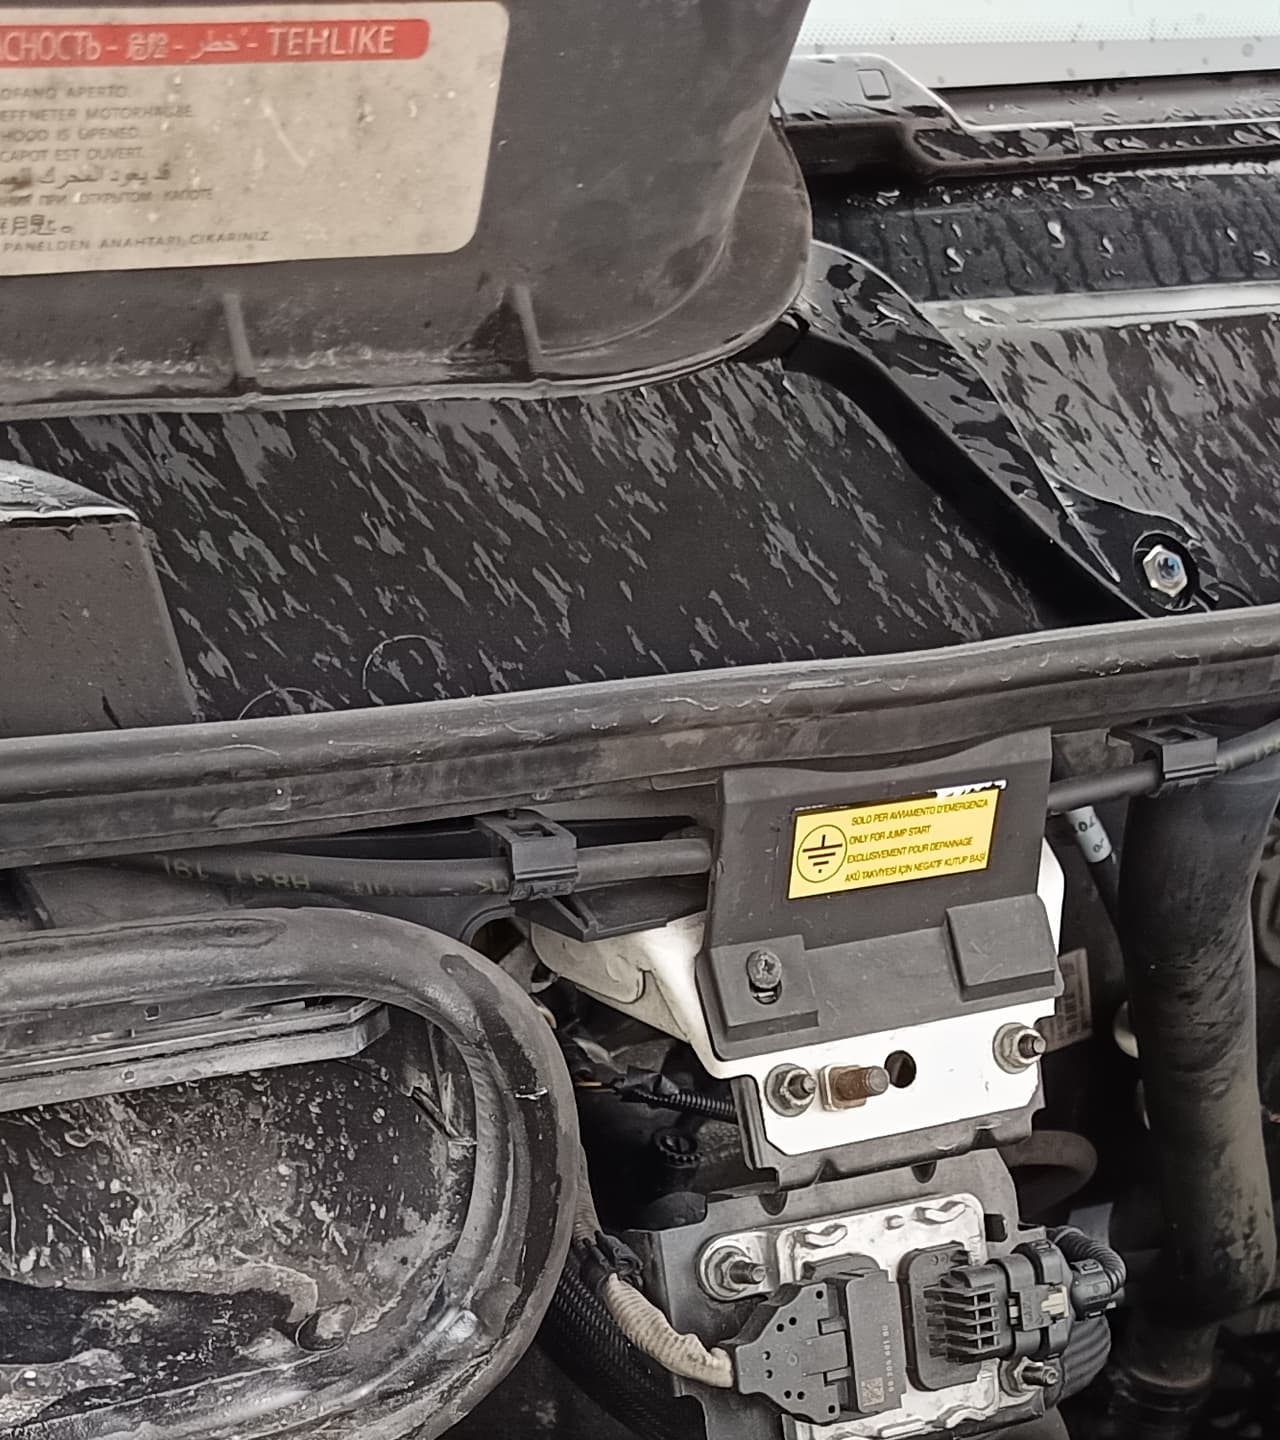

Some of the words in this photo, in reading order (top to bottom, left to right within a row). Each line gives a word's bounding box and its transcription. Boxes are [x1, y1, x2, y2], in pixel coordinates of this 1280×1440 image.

[267, 26, 397, 58] TEHLIKE
[0, 127, 48, 143] HOOD
[56, 127, 70, 142] IS
[0, 148, 49, 164] CAPOT
[55, 147, 80, 163] EST
[851, 814, 872, 827] SOLO
[873, 812, 888, 823] PER
[849, 834, 869, 846] ONLY
[870, 832, 885, 842] FOR
[887, 827, 908, 839] JUMP
[909, 824, 931, 836] START
[908, 842, 931, 855] POUR
